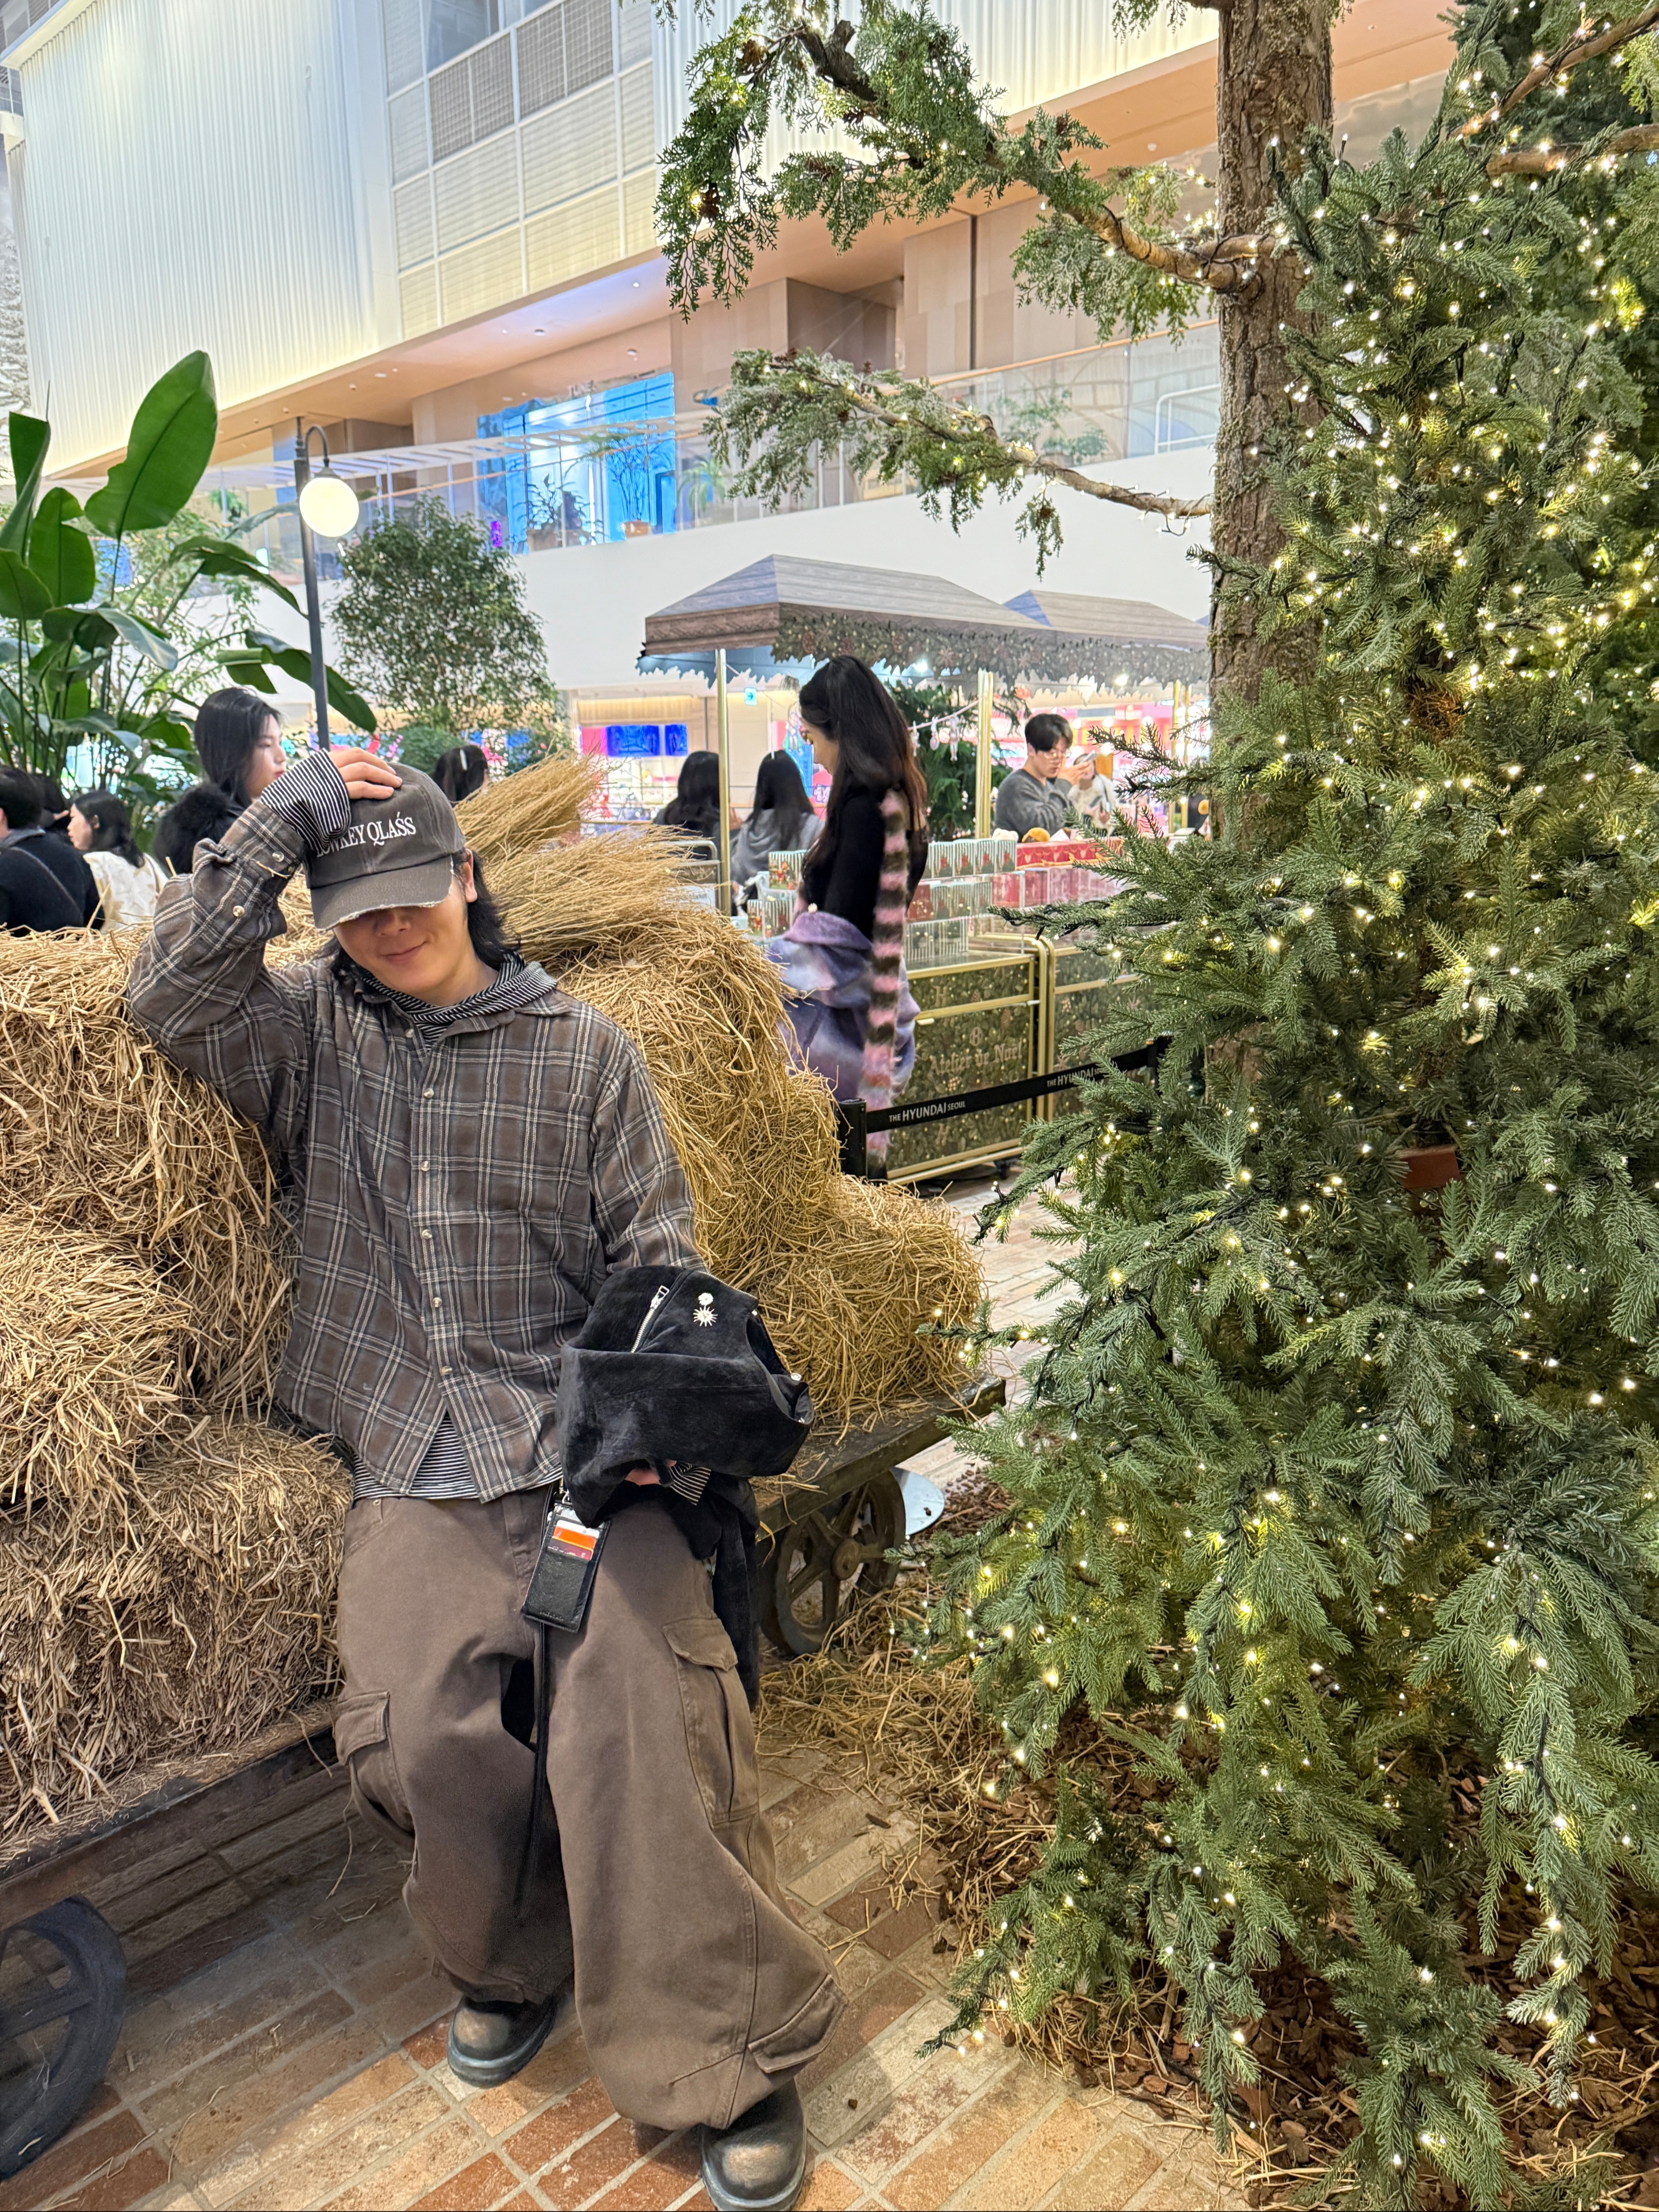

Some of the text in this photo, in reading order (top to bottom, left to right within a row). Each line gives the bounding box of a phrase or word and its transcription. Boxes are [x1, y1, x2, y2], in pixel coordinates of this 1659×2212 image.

[930, 1051, 972, 1076] Atelier
[975, 1049, 990, 1067] de
[1047, 1078, 1057, 1087] THE
[889, 1101, 966, 1122] THE HYUNDAI SEOUL
